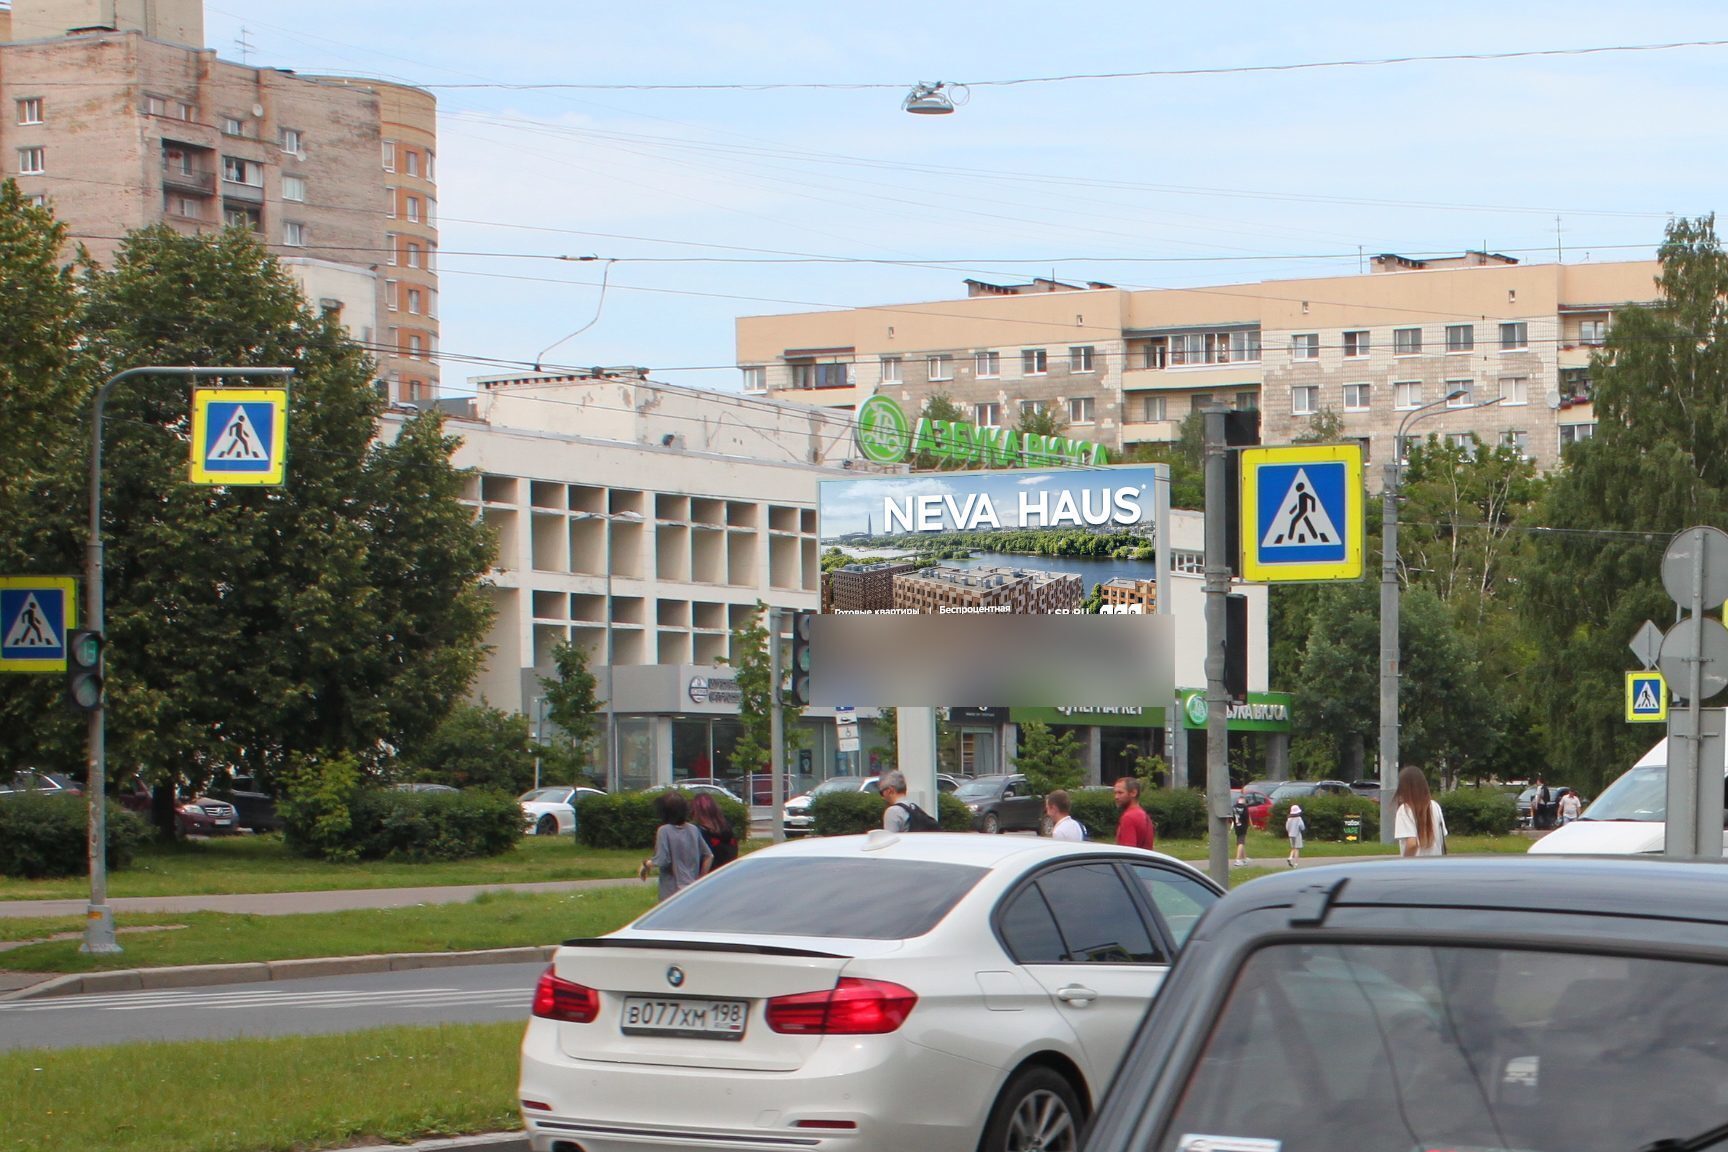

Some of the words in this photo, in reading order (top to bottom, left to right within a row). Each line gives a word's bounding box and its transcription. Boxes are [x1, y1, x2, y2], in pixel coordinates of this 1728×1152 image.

[912, 417, 1024, 467] АЗБУКА
[884, 492, 1000, 533] NEVA
[1253, 704, 1289, 720] ВКУСА
[711, 1004, 741, 1022] 198
